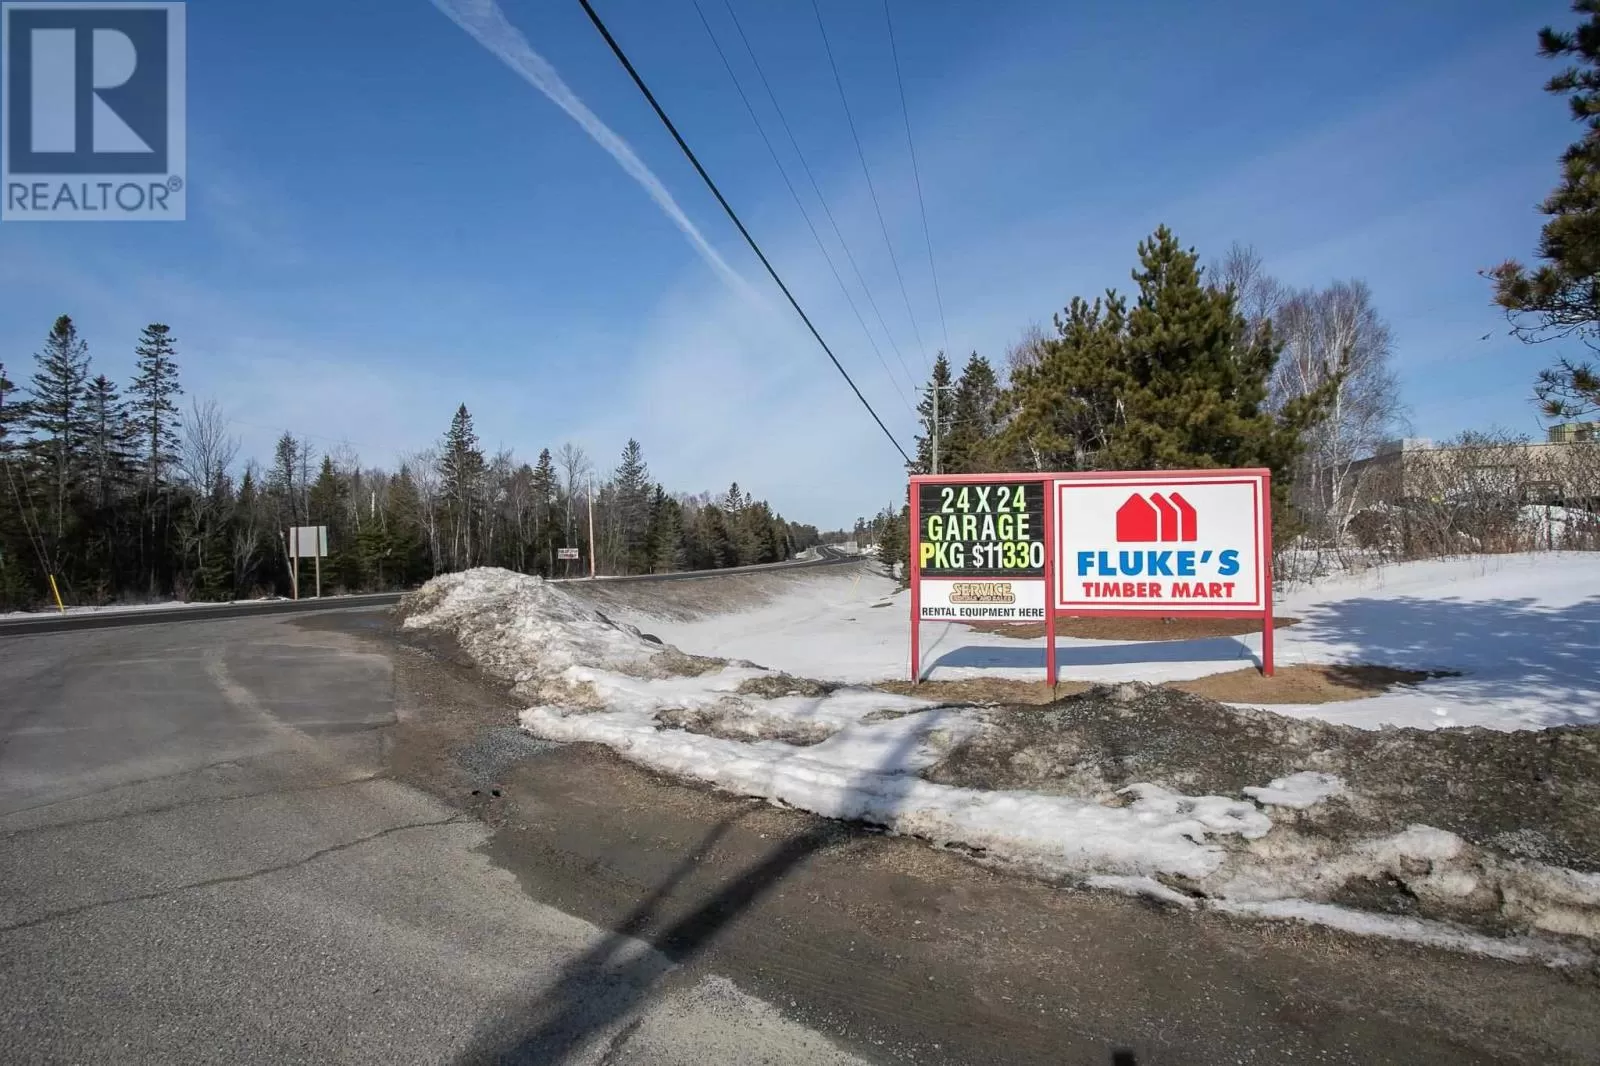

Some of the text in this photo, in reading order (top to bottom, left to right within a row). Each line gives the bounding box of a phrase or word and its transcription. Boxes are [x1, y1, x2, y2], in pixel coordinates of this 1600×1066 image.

[941, 485, 1026, 513] 24 X 24
[928, 514, 1030, 541] GARAGE
[920, 541, 1044, 568] PKG $11330
[1077, 549, 1240, 576] FLUKE'S
[953, 583, 1012, 597] SERVICE
[1082, 582, 1235, 598] TIMBER MART
[922, 607, 1044, 617] RENTAL EQUIPMENT HERE
